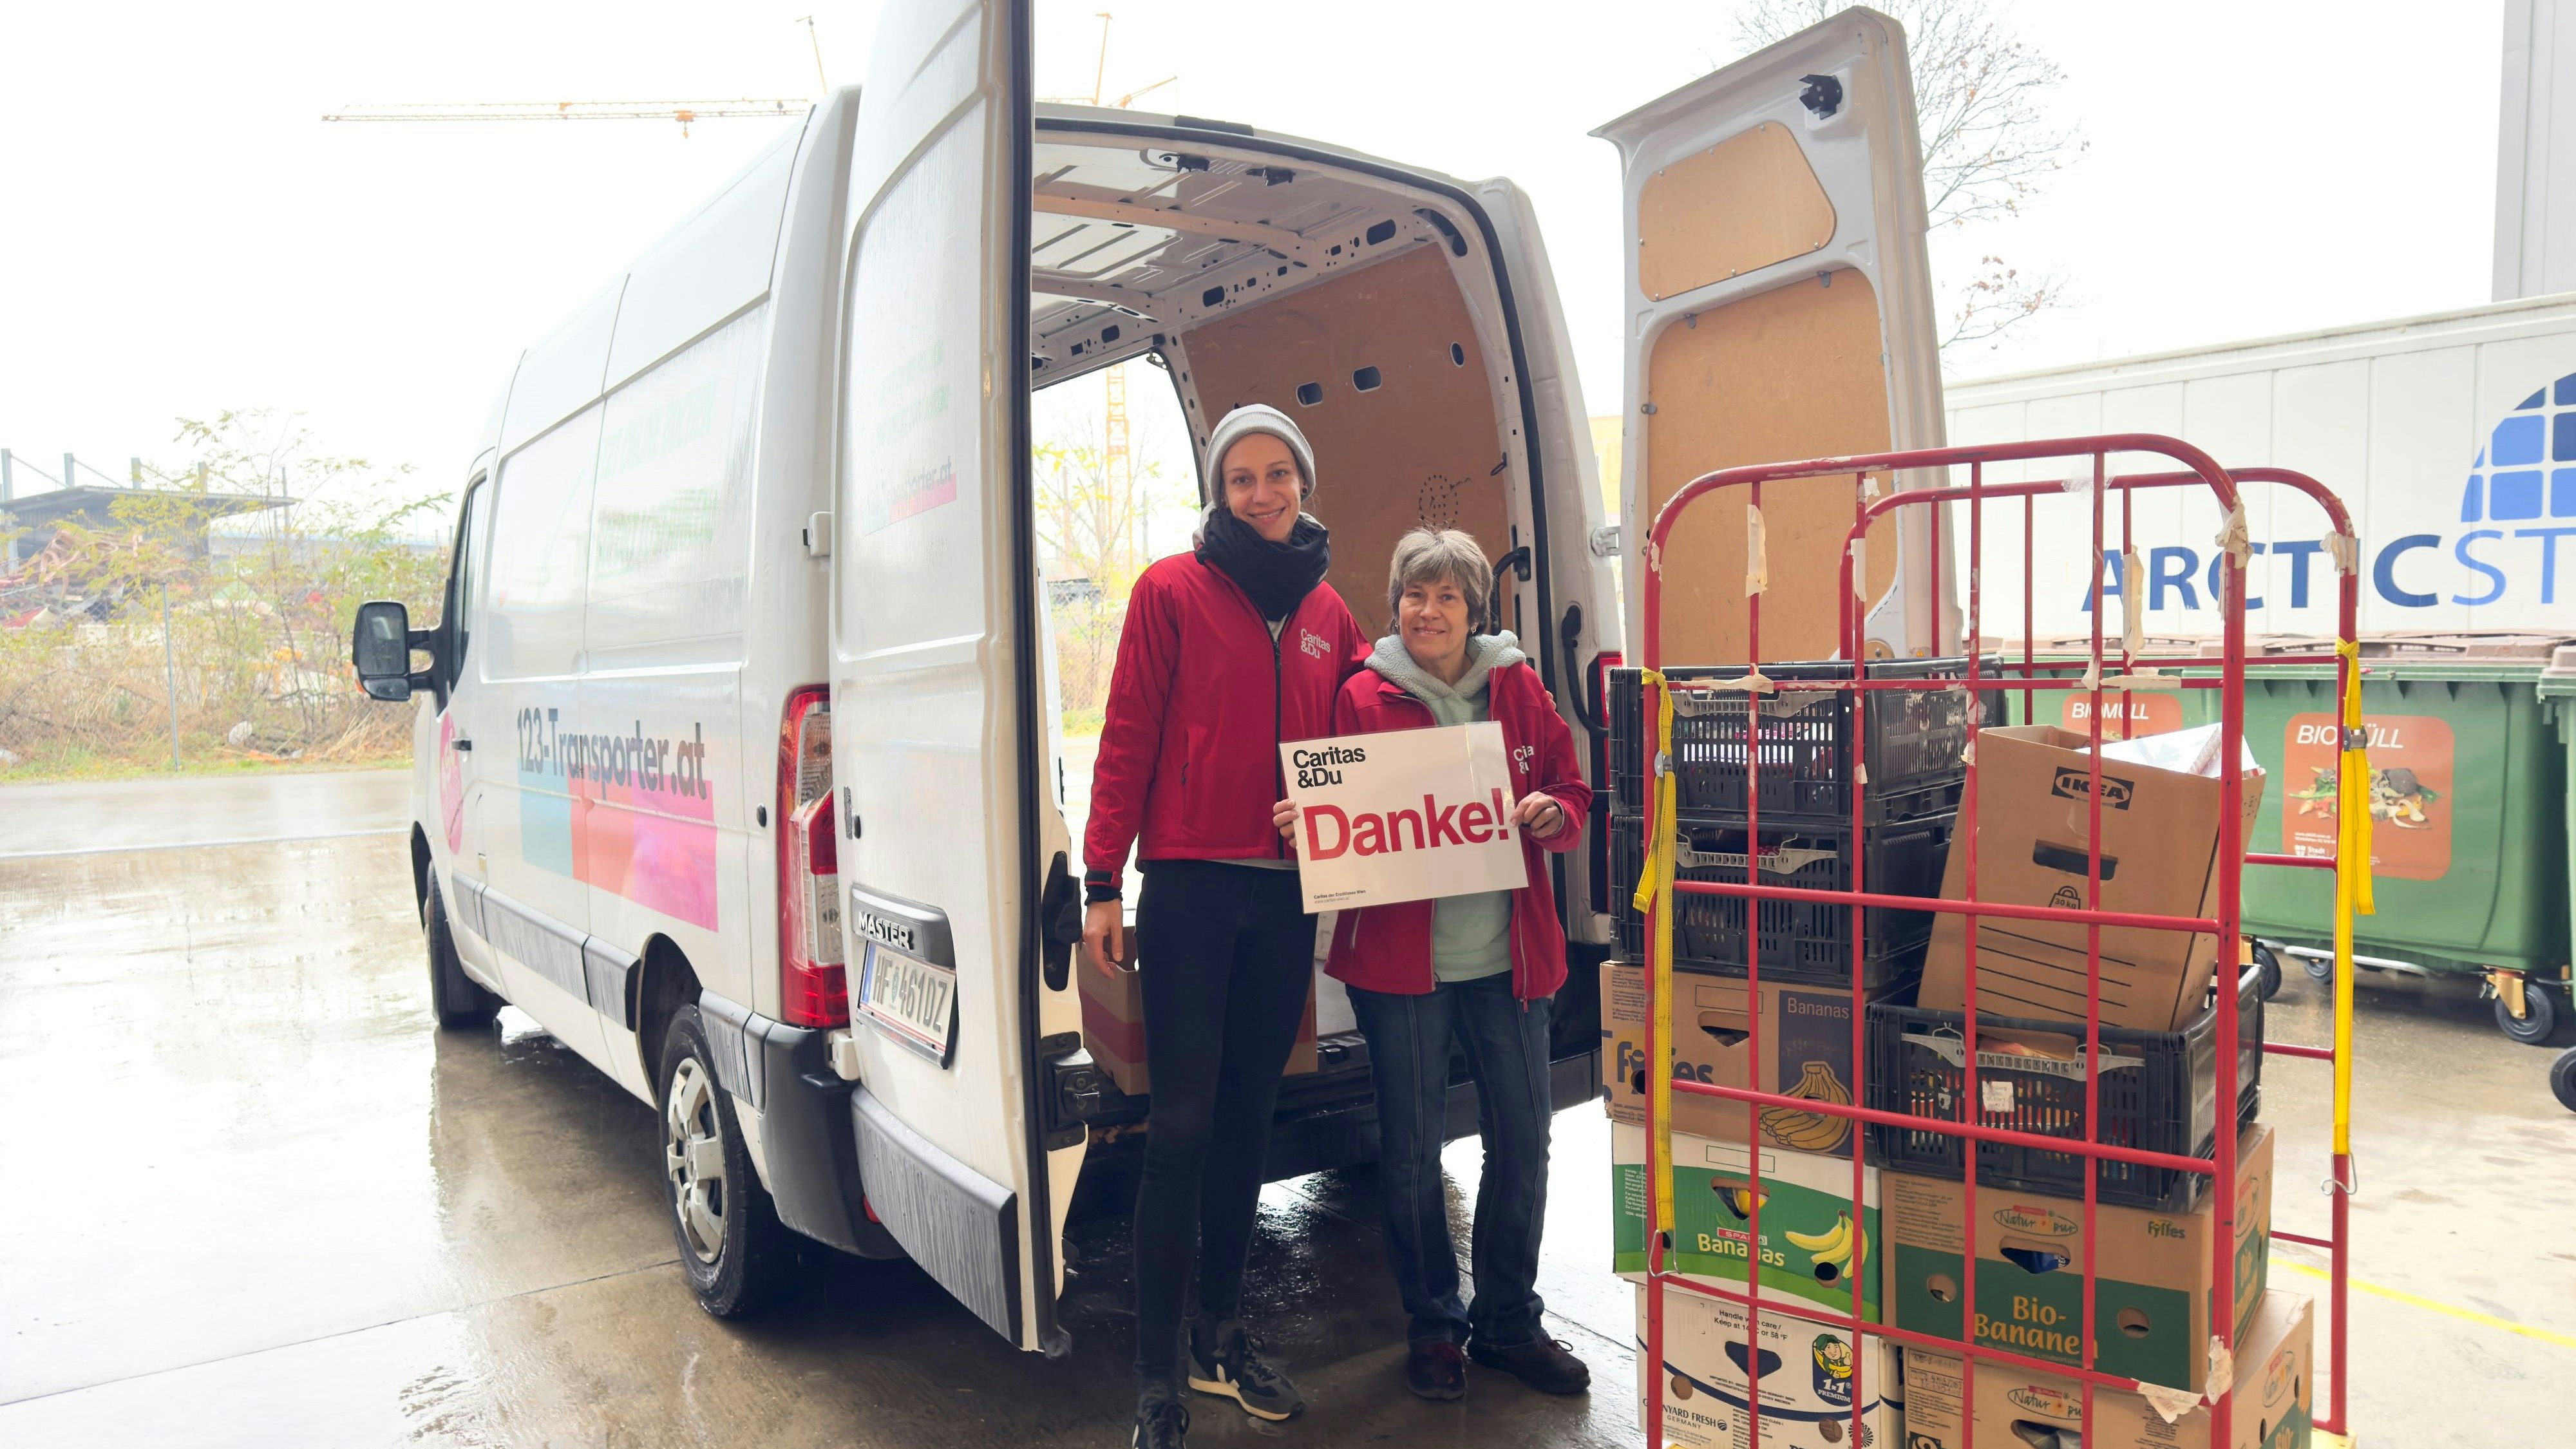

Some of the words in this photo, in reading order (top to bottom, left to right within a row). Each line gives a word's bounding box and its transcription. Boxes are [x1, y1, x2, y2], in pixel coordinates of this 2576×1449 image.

[1301, 628, 1331, 653] Caritas
[1301, 640, 1320, 659] &Du
[2297, 724, 2403, 748] BIOÜLL
[517, 707, 707, 800] 123-Transporter.at
[1293, 746, 1366, 769] Caritas
[1298, 767, 1343, 789] &Du
[1302, 788, 1509, 862] Danke!
[858, 911, 912, 951] MASTER
[1787, 998, 1850, 1019] Bananas
[1999, 1211, 2036, 1229] Natur
[2053, 1222, 2076, 1235] pur
[1725, 1231, 1750, 1241] SPA
[1697, 1233, 1785, 1267] Banaas
[1719, 1310, 1744, 1321] Handle
[2013, 1295, 2066, 1326] Bio-
[1714, 1317, 1732, 1327] Keep
[1974, 1313, 2098, 1359] Banane
[1817, 1388, 1851, 1403] PREMIUM
[2014, 1390, 2050, 1410] Natur
[1667, 1415, 1701, 1430] GERMANY
[1691, 1412, 1716, 1427] FRESH
